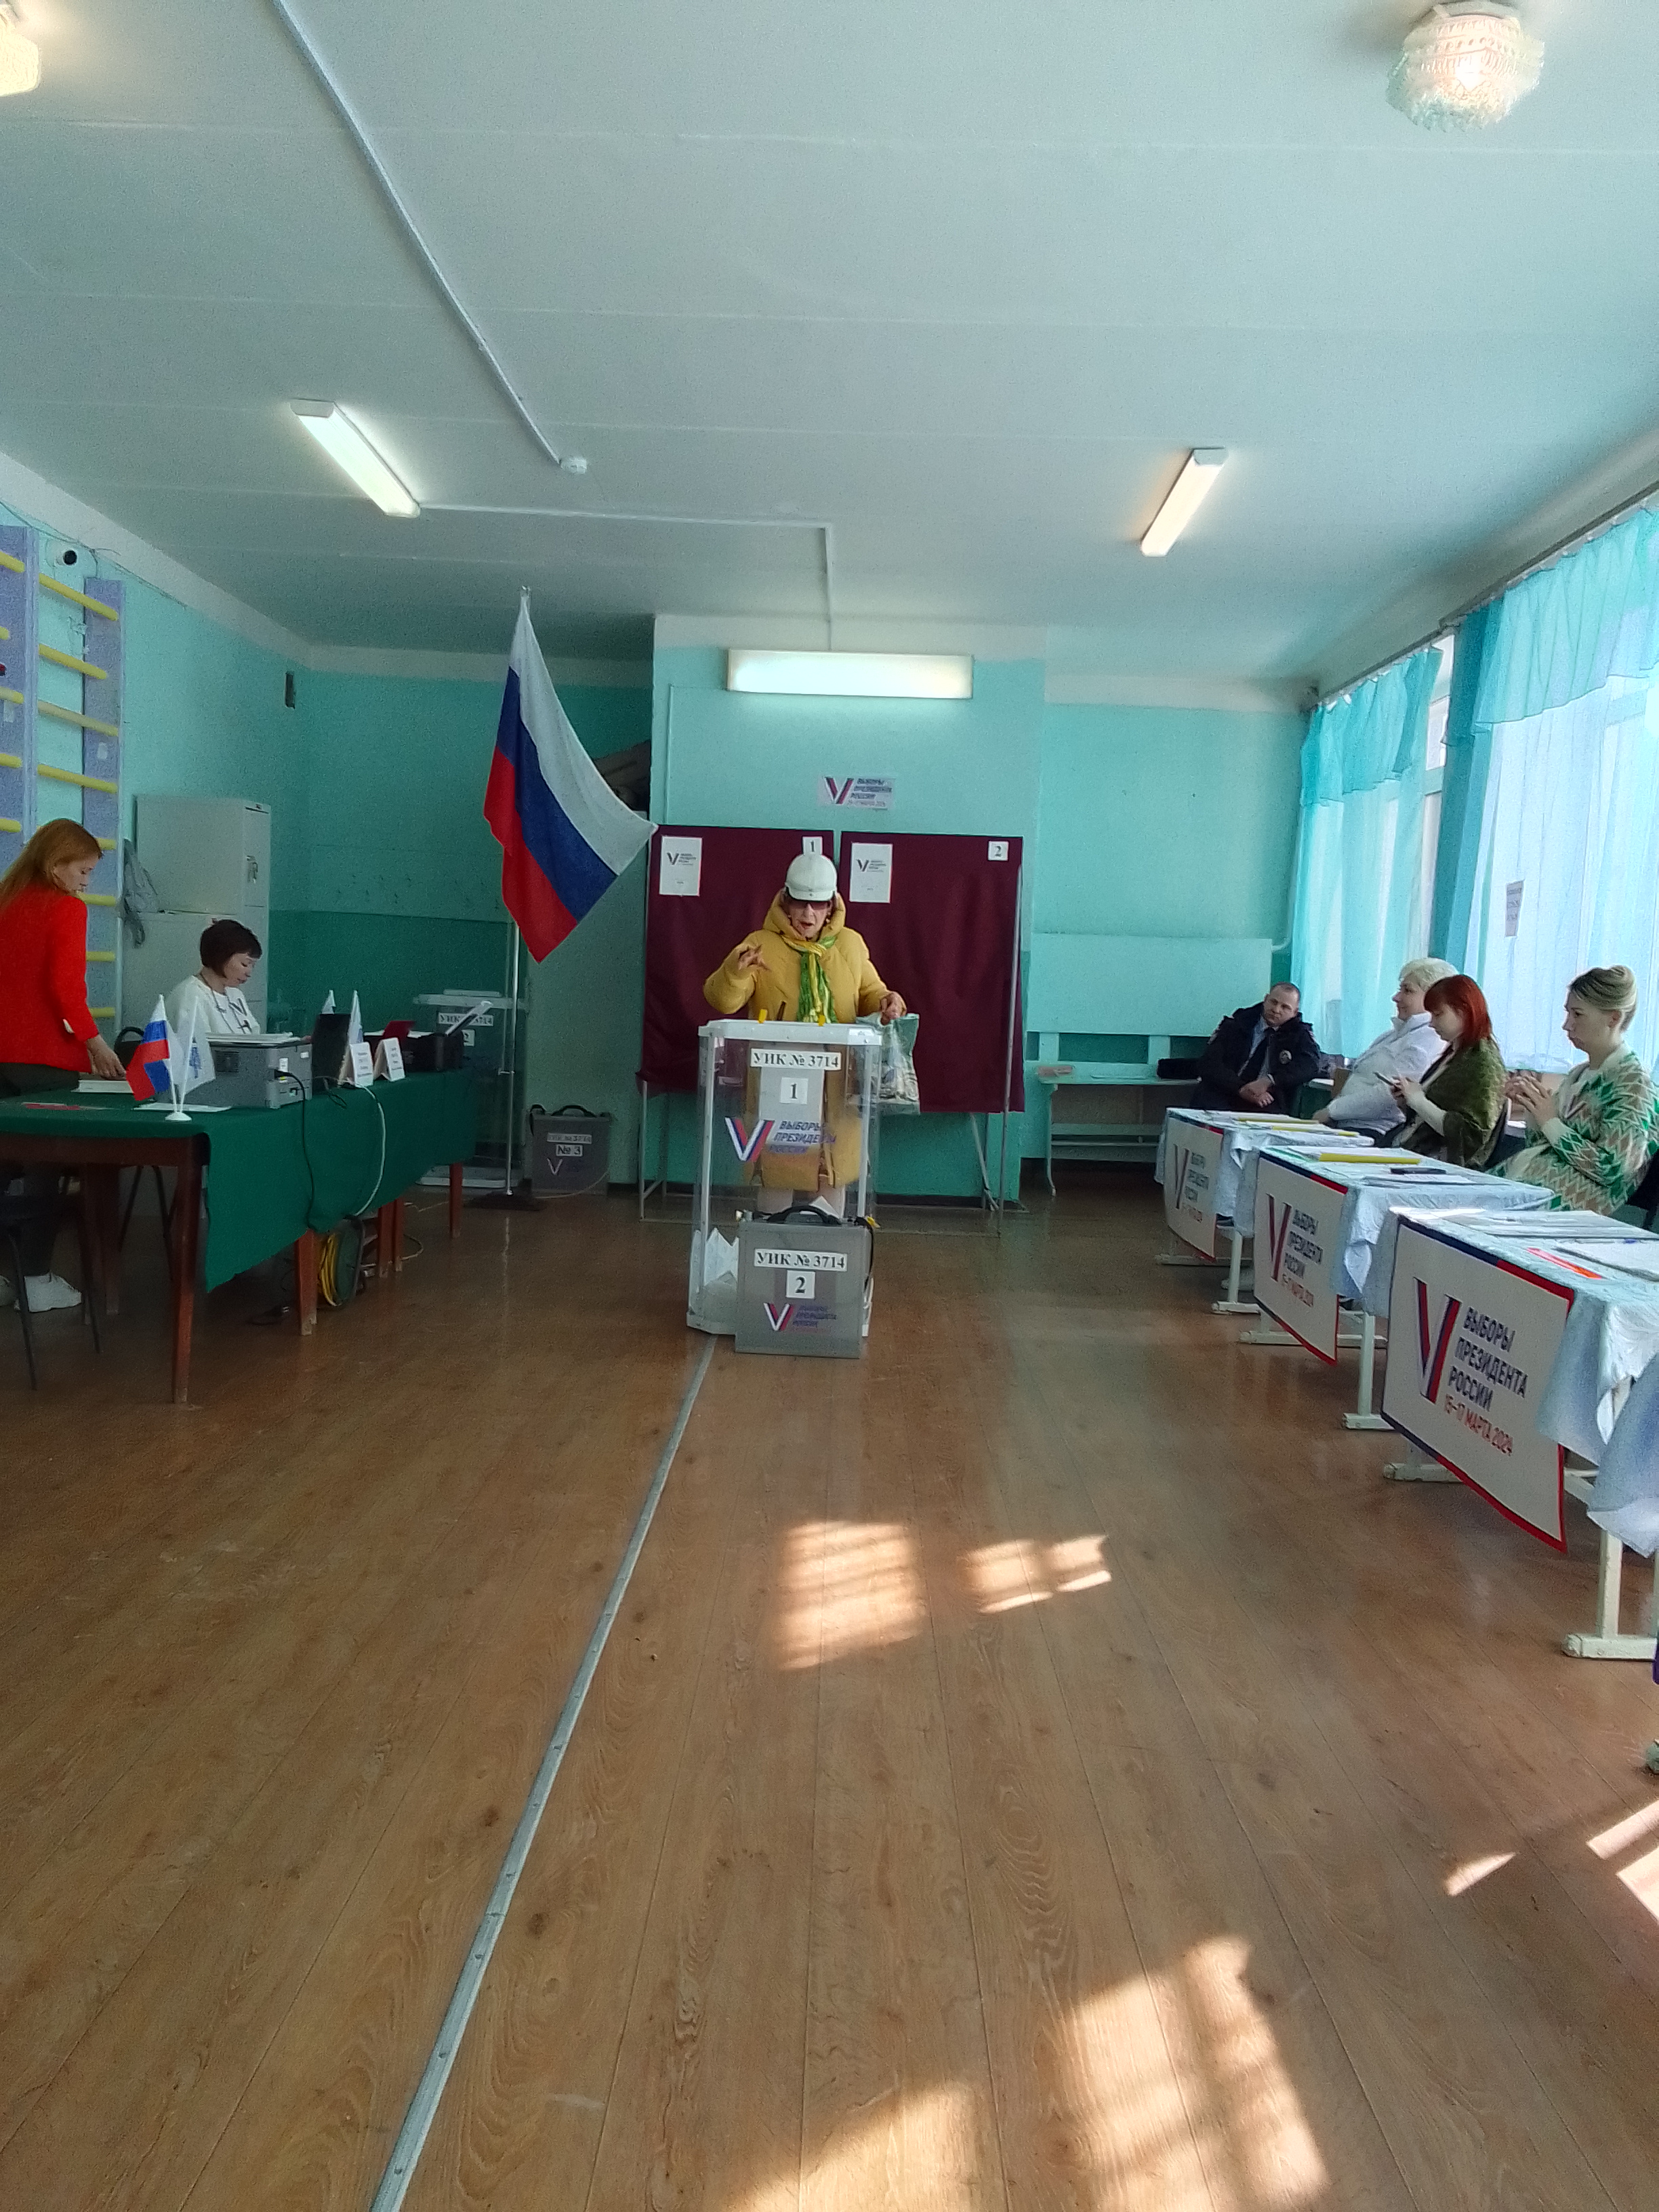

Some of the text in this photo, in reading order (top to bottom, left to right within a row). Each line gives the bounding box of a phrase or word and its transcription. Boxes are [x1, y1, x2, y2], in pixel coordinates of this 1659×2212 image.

[994, 845, 1002, 857] 2
[754, 1052, 839, 1067] УИК № 3714
[790, 1083, 798, 1099] 1
[558, 1145, 581, 1155] № 3
[757, 1252, 844, 1269] УИК № 3714
[795, 1276, 806, 1294] 2
[1463, 1306, 1516, 1353] ВЫБОРЫ
[1454, 1336, 1529, 1399] ПРЕЗИДЕНТА
[1448, 1365, 1494, 1412] РОССИИ
[1465, 1408, 1492, 1442] МАРТА
